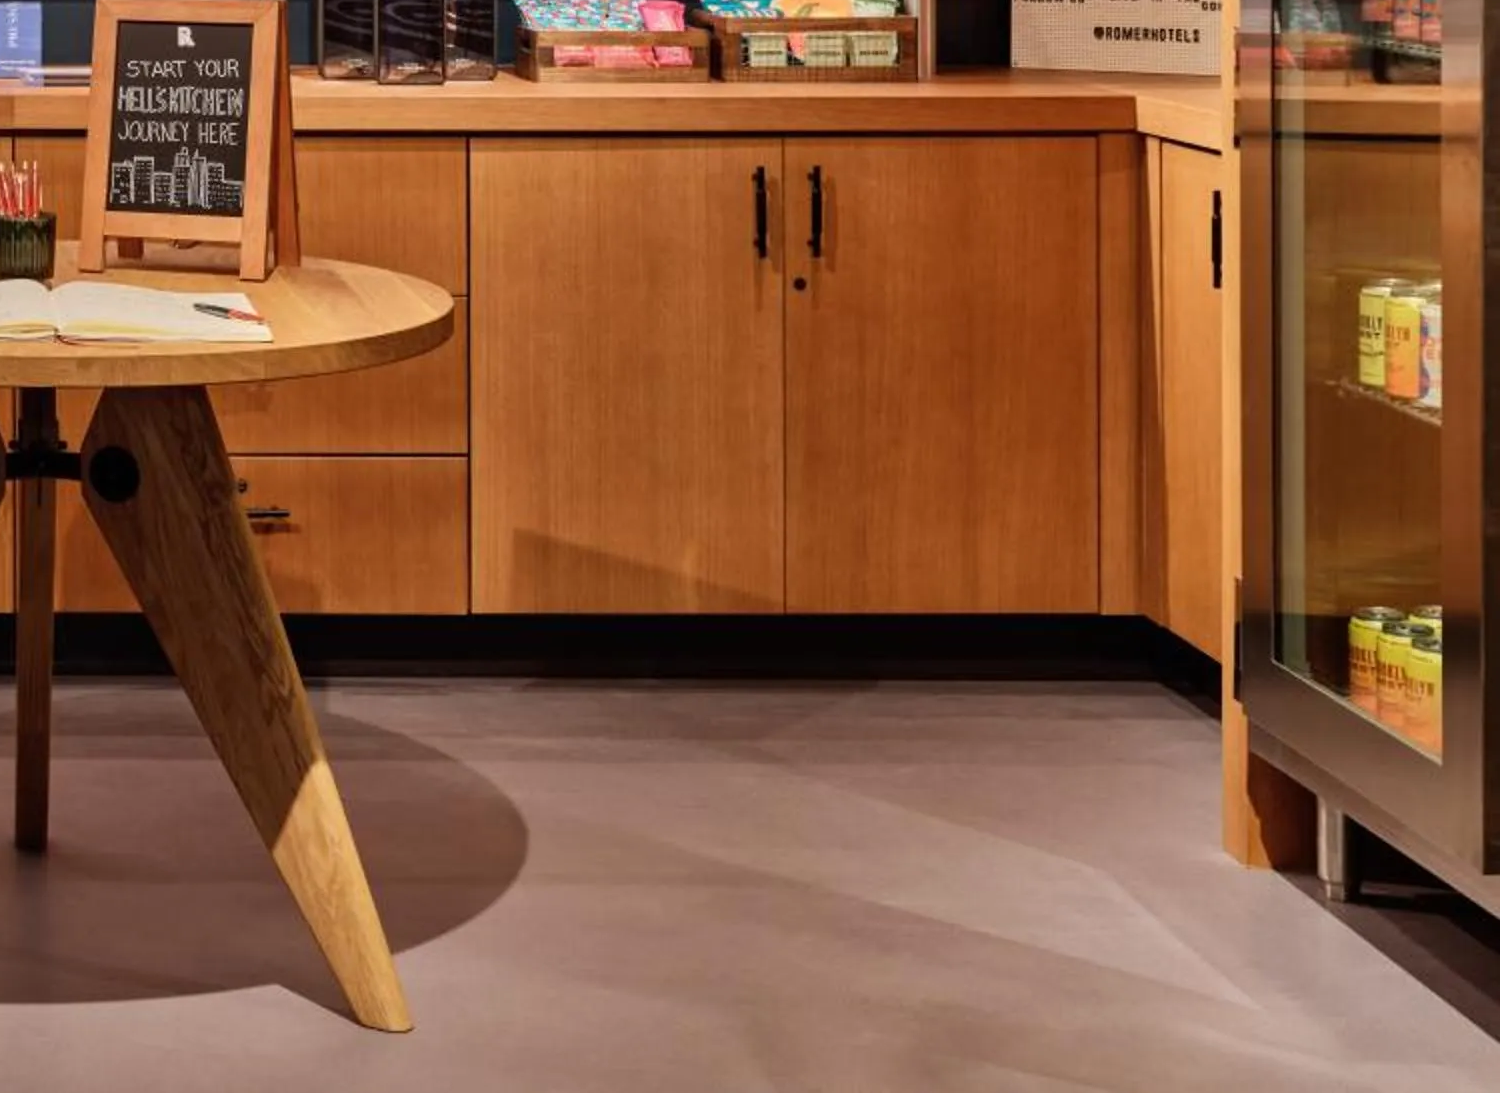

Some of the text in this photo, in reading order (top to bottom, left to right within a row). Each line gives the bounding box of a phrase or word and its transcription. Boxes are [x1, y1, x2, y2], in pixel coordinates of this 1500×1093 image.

[126, 57, 241, 79] START YOUR
[167, 85, 244, 118] KITCHEN
[117, 119, 242, 146] JOURNEY HERE
